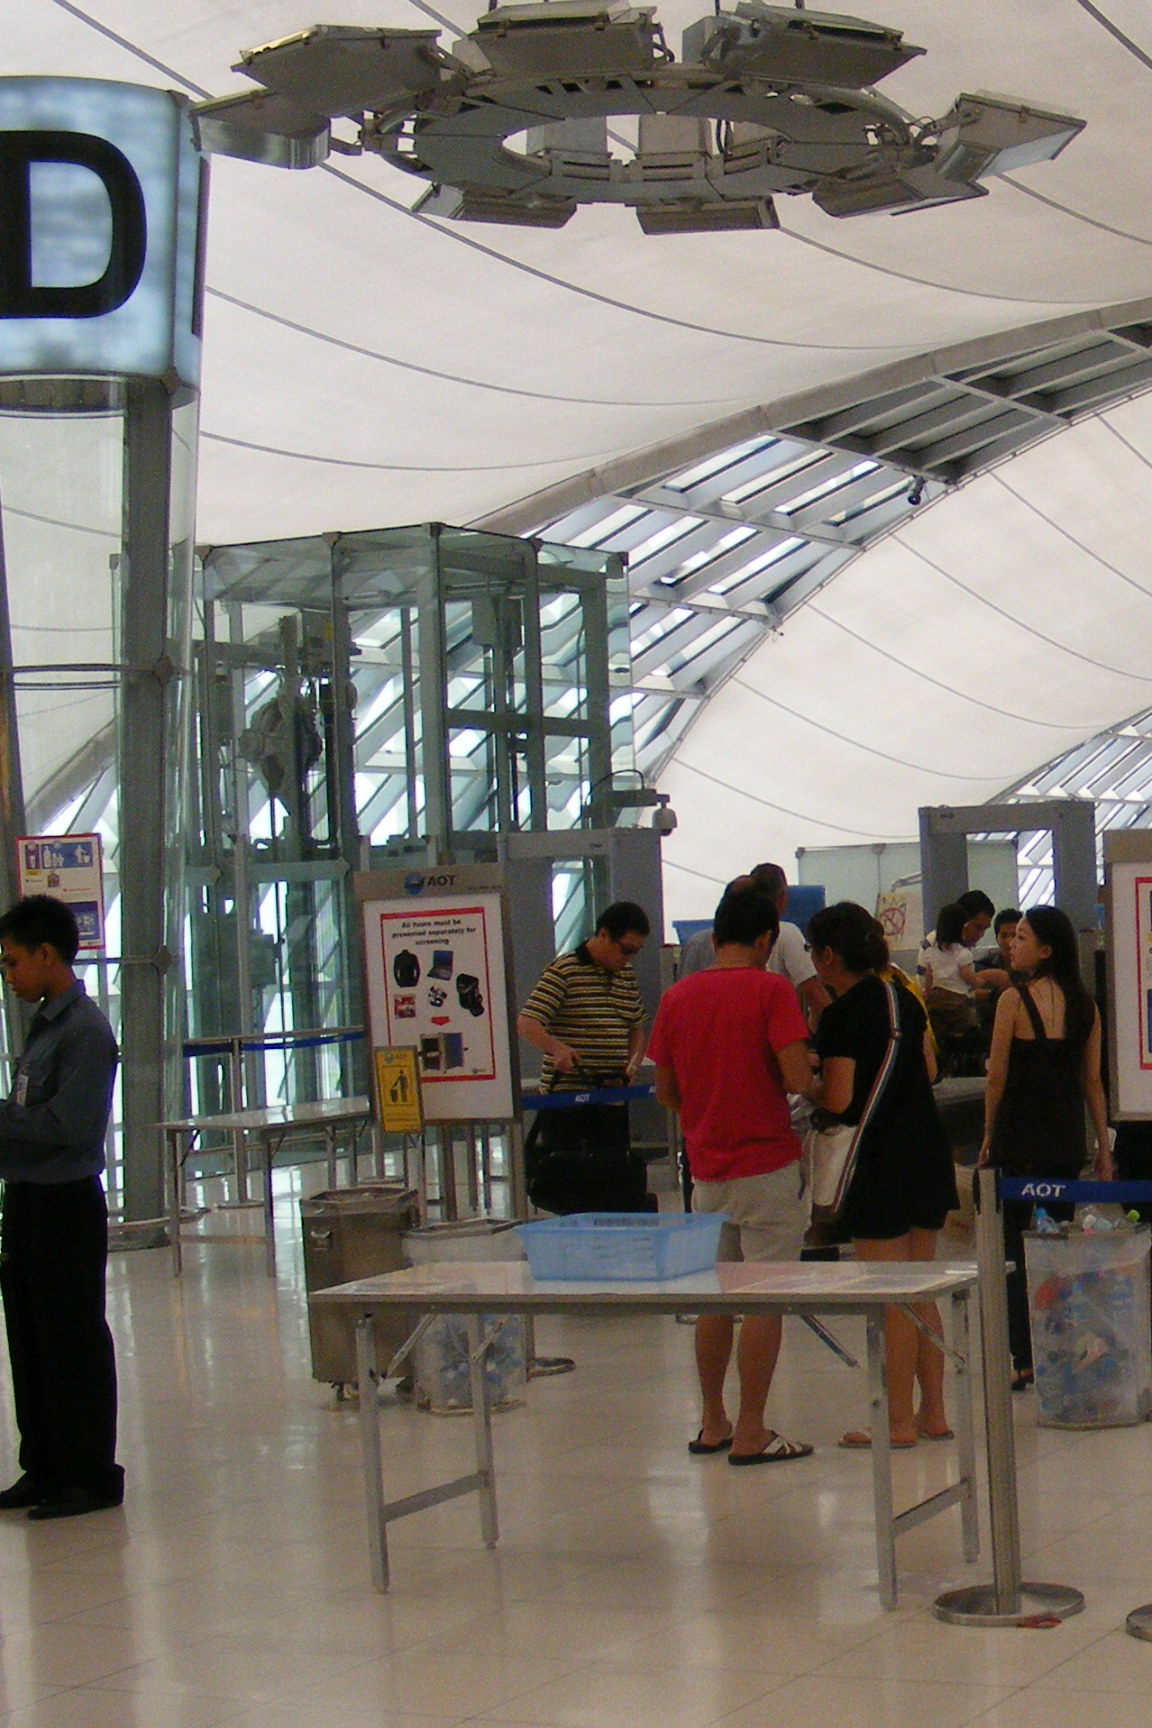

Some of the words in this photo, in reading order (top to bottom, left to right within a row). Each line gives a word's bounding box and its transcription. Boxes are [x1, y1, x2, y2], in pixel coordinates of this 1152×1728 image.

[0, 130, 147, 319] D
[427, 874, 456, 887] AOT
[575, 1093, 591, 1103] AOT
[1021, 1182, 1067, 1199] AOT
